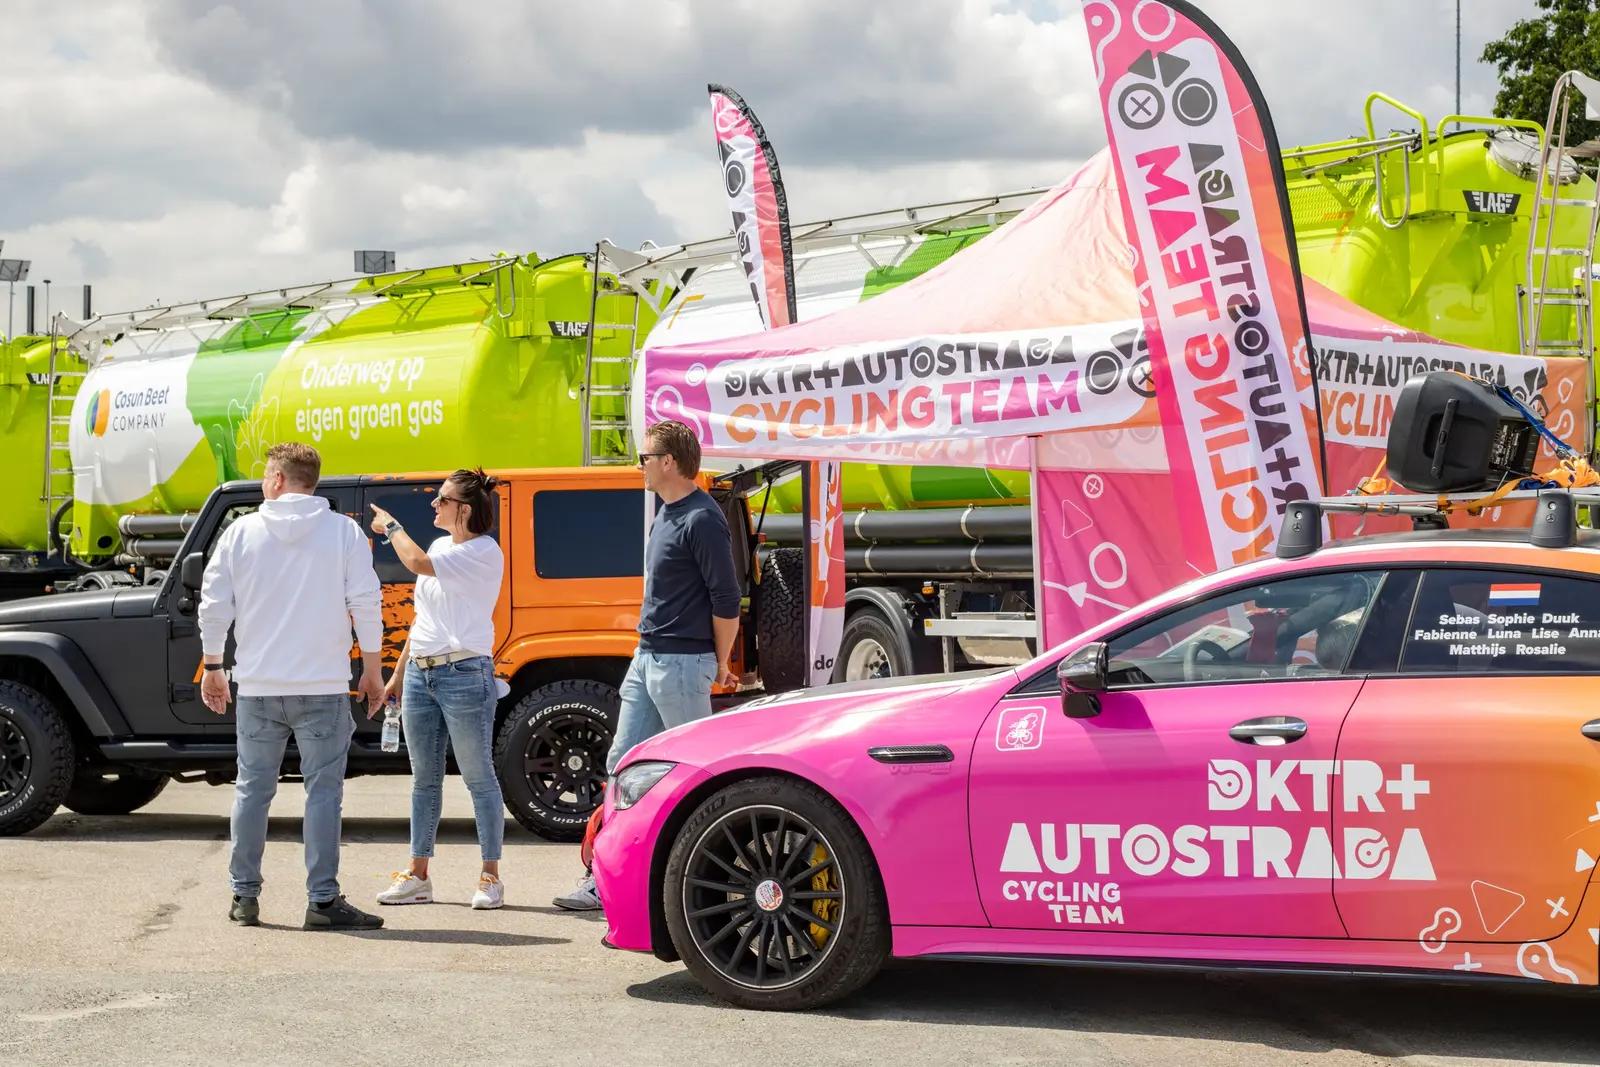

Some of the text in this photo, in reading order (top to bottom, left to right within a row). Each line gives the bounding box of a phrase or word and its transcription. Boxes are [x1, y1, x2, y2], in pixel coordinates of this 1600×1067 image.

[1480, 191, 1506, 213] LAG
[561, 321, 582, 336] LAG
[301, 355, 424, 394] Onderweg op
[114, 385, 170, 409] Cosun Beet
[725, 370, 1082, 444] CYCLING TEAM
[112, 412, 166, 431] COMPANY
[295, 399, 444, 442] eigen groen gas
[1320, 388, 1396, 437] YCLIN
[1439, 612, 1580, 626] Sebas Sophie Duuk
[1414, 629, 1477, 641] Fabienne
[1488, 628, 1521, 639] Luna
[1532, 627, 1559, 639] Lise
[1449, 644, 1566, 657] Matthijs Rosalie
[528, 702, 608, 727] BFGoodrich
[1208, 758, 1430, 813] DKTR+
[0, 784, 35, 816] BFGoo
[528, 801, 592, 825] rrain T/A
[999, 822, 1437, 881] AUTOSTRADA
[1002, 881, 1121, 904] CYCLING
[1048, 904, 1125, 925] TEAM
